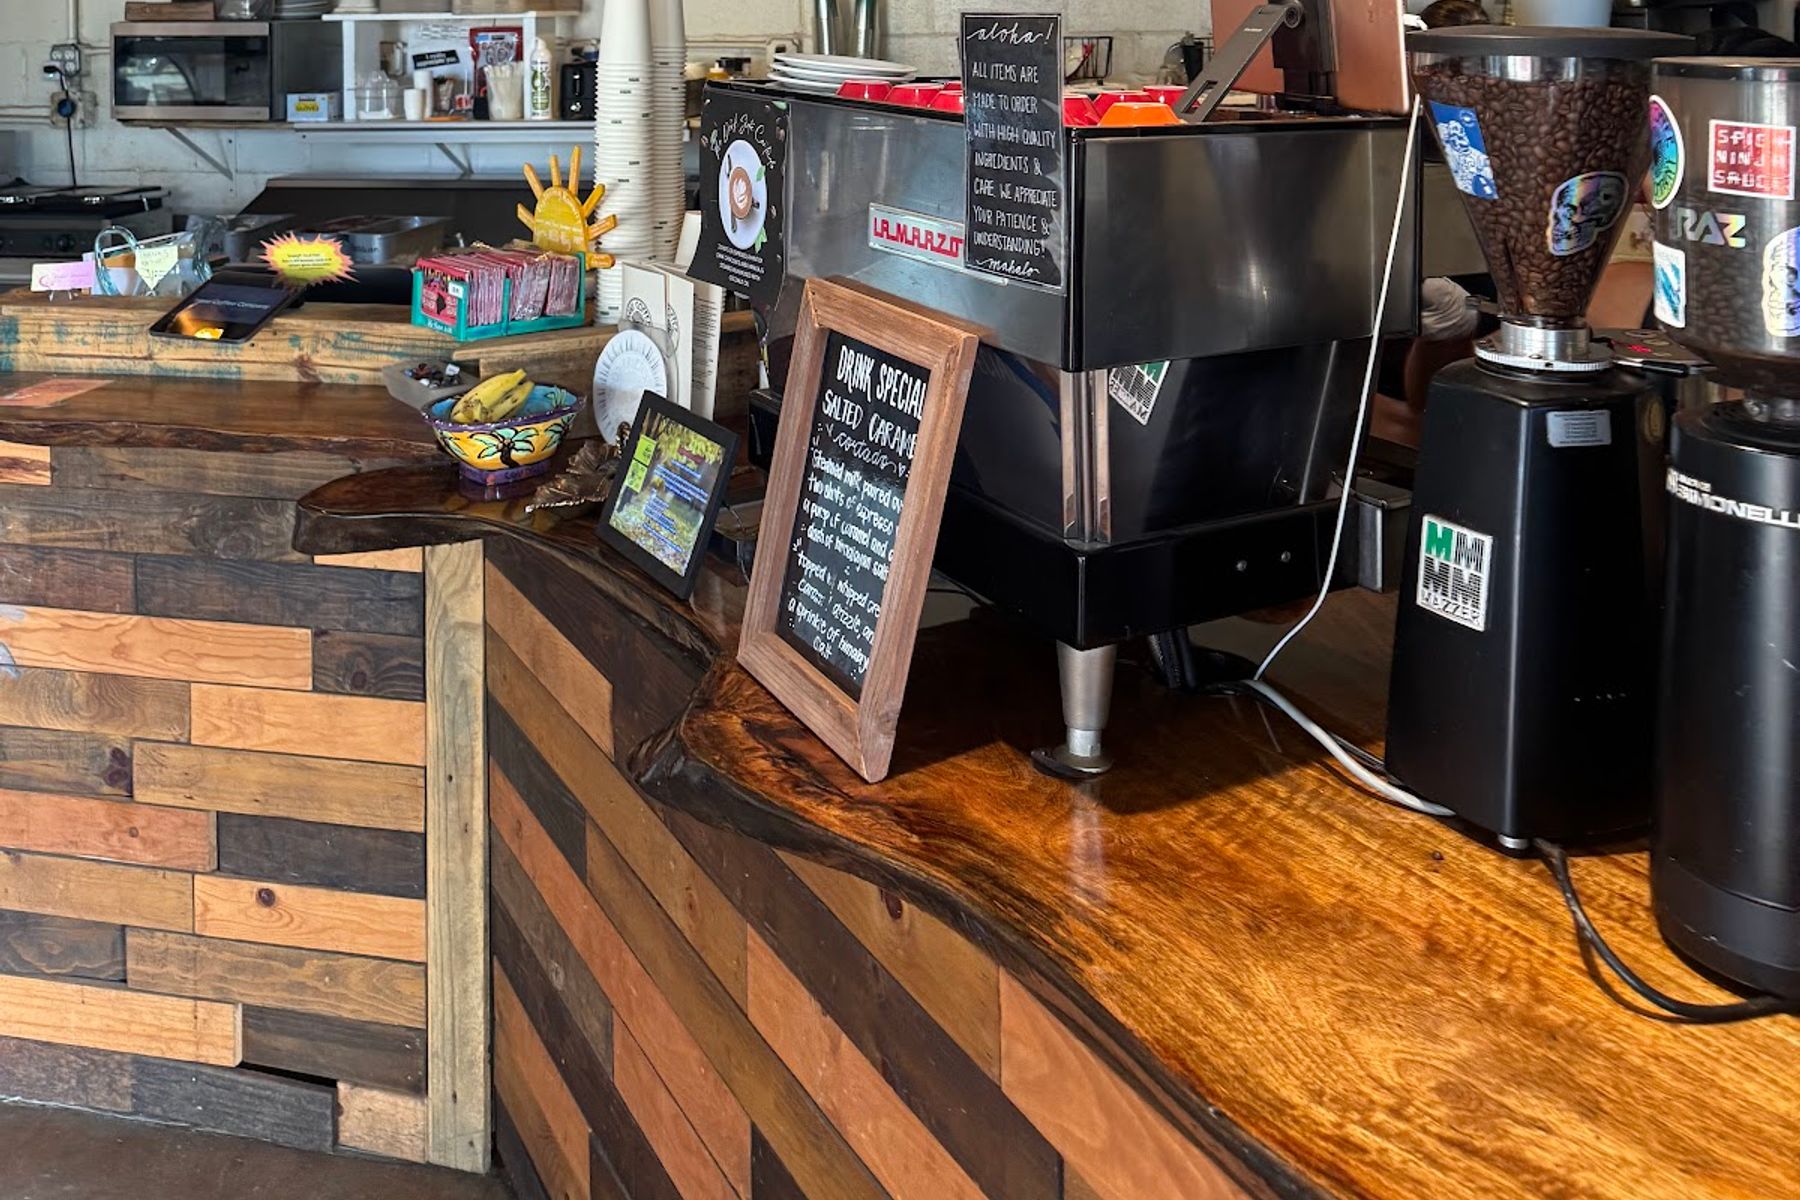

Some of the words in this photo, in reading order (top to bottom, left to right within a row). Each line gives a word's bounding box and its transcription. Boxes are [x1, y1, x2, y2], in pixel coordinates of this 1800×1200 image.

[966, 21, 1054, 45] aloha!
[972, 61, 988, 79] ALL
[990, 62, 1017, 83] ITEMS
[1020, 65, 1040, 85] ARE
[972, 91, 996, 115] MADE
[997, 94, 1010, 116] TO
[1011, 95, 1038, 119] ORDER
[973, 121, 996, 140] WITH
[997, 123, 1020, 143] HIGH
[1021, 128, 1056, 149] QUALITY
[974, 151, 1029, 174] INGREDIENTS
[1033, 157, 1042, 176] &
[1000, 182, 1012, 199] WE
[1013, 186, 1057, 208] APPRECIATE
[973, 204, 993, 225] YOUR
[995, 210, 1037, 233] PATIENCE
[1041, 217, 1050, 236] &
[973, 230, 1046, 259] UNDERSTANDING!
[976, 258, 1041, 278] mahalo
[836, 344, 876, 403] DRINK
[822, 389, 864, 431] SALTED
[808, 471, 824, 495] two
[823, 480, 845, 507] shots
[846, 495, 857, 509] of
[856, 502, 894, 536] espresso
[861, 480, 892, 508] poured
[810, 502, 831, 528] pump
[841, 521, 872, 548] caramel
[870, 537, 889, 558] and
[797, 550, 827, 581] topped
[837, 579, 869, 609] whipped
[796, 601, 828, 635] sprinkle
[826, 626, 840, 642] of
